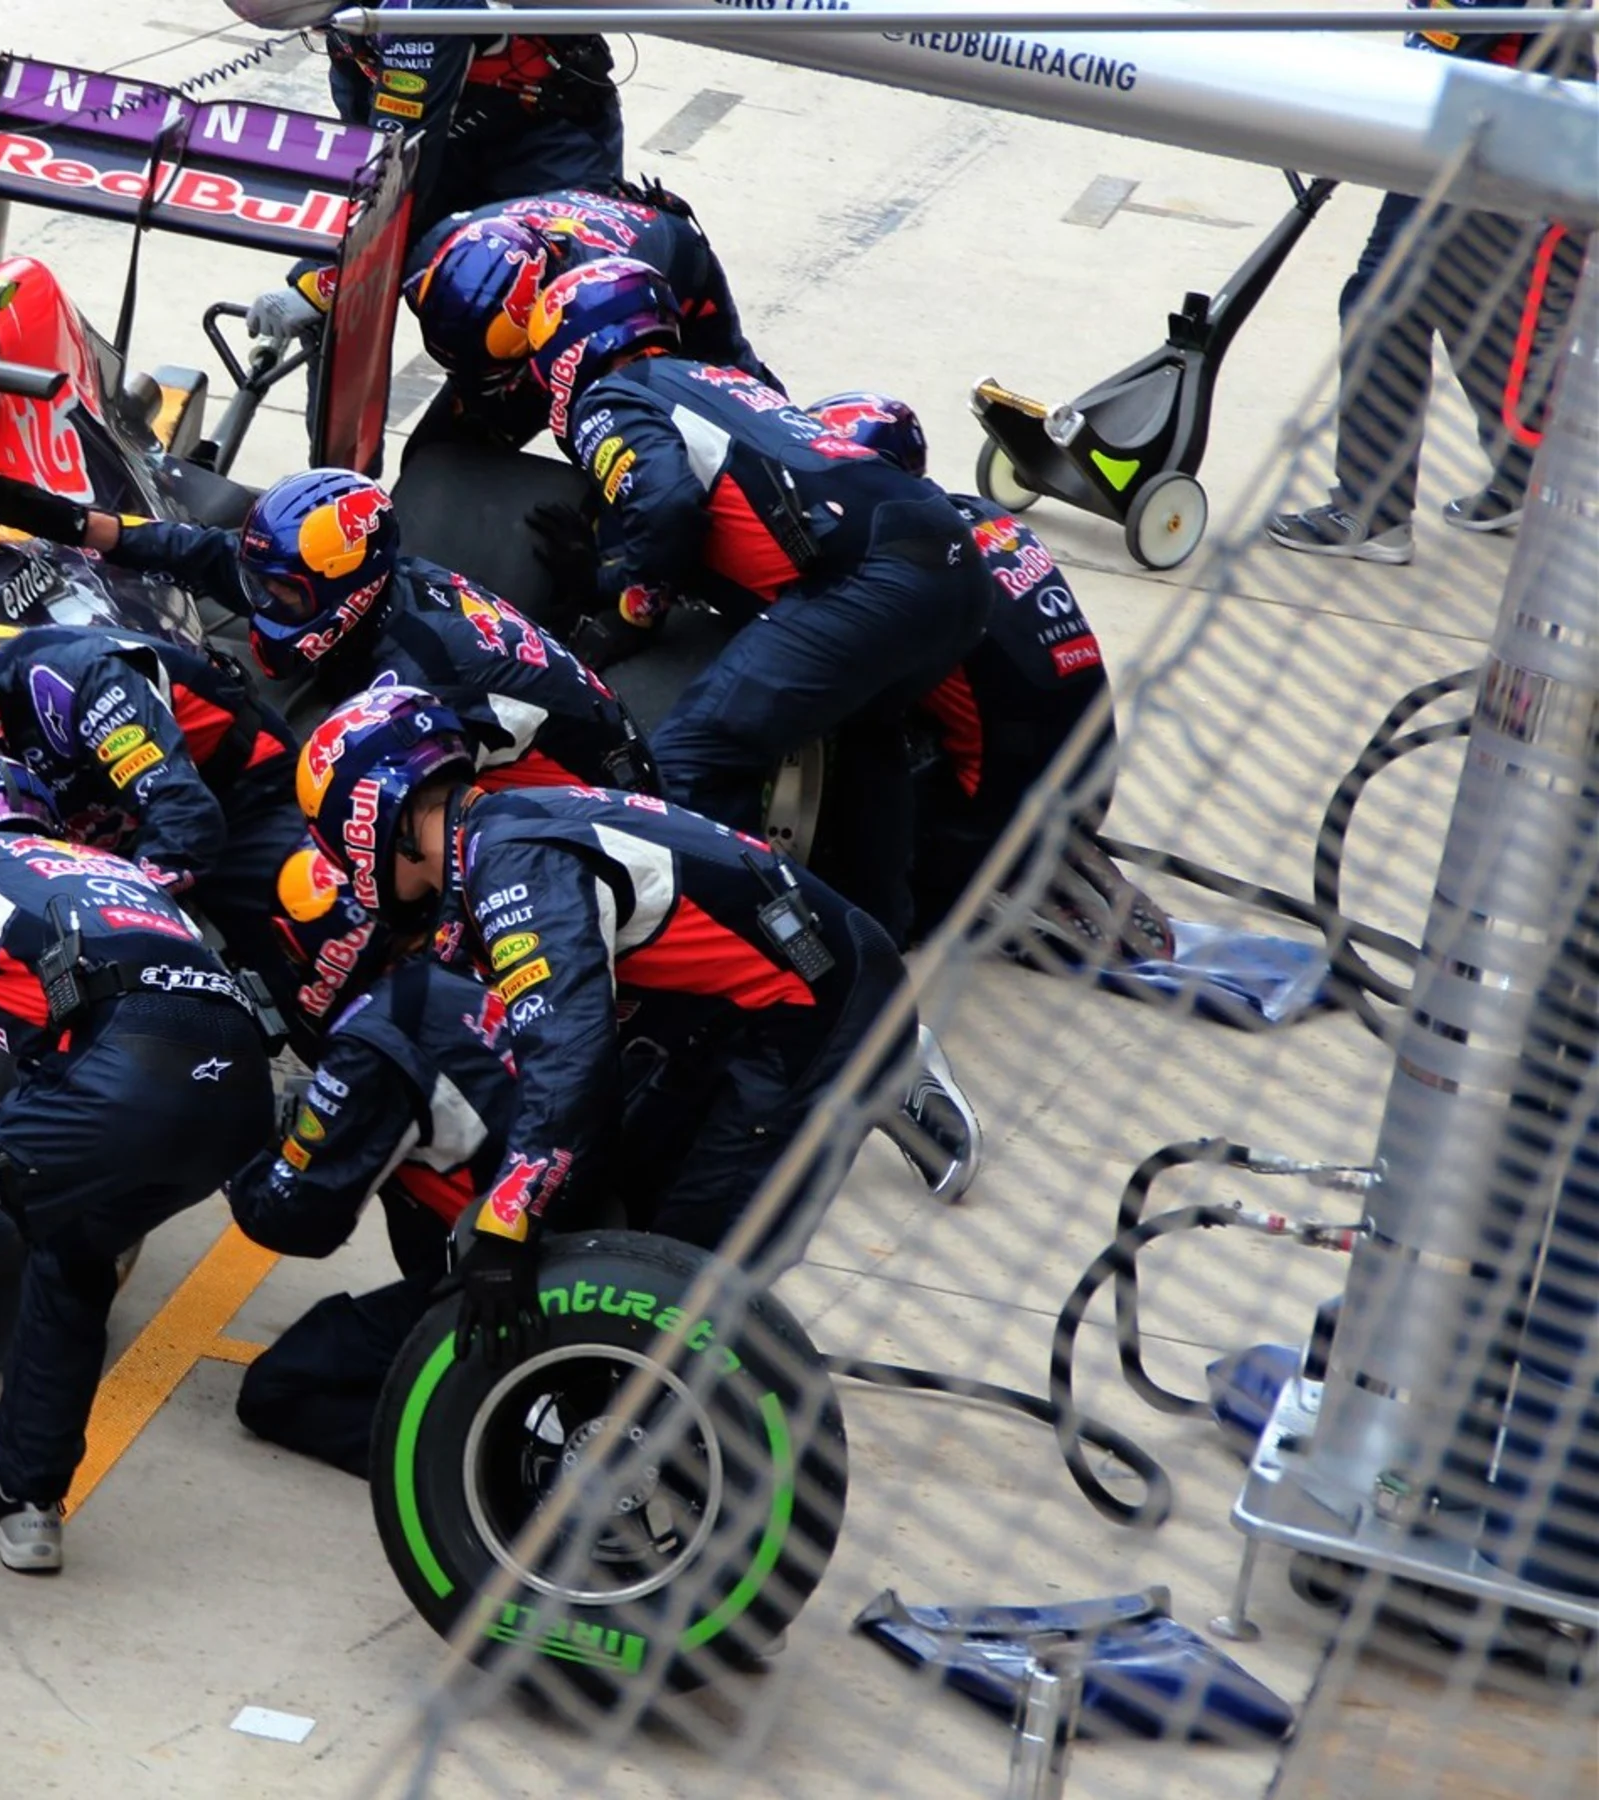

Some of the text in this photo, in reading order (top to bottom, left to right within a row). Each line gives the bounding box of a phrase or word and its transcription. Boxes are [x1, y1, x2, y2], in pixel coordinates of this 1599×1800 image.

[3, 61, 387, 171] INFINITI
[1056, 647, 1097, 668] TOTAL
[79, 685, 126, 737] CASIO
[501, 963, 544, 999] PIRELLI
